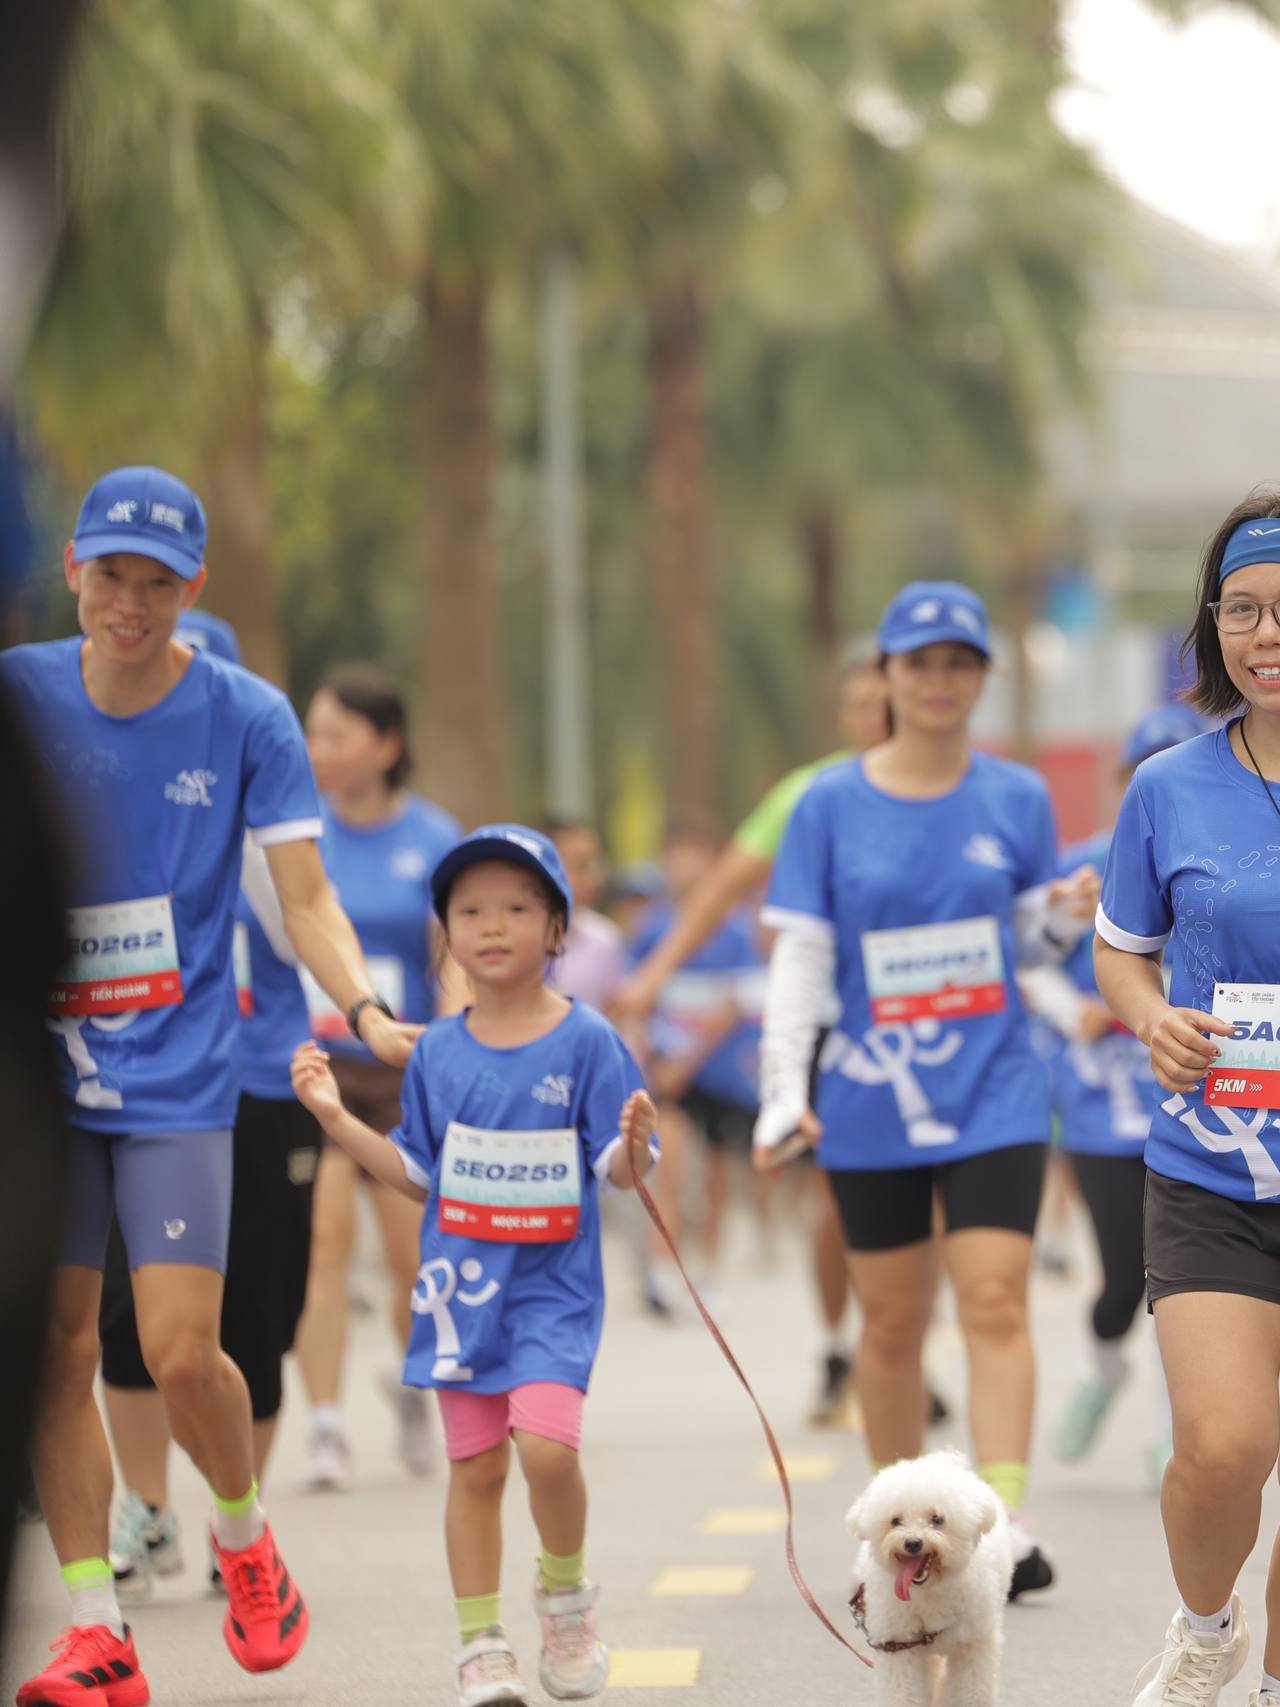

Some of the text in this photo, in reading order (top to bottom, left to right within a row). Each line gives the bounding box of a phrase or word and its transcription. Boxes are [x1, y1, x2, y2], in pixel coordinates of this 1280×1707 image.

[67, 930, 164, 956] E0262
[1214, 1079, 1247, 1092] 5KM
[452, 1158, 568, 1182] 5E0259
